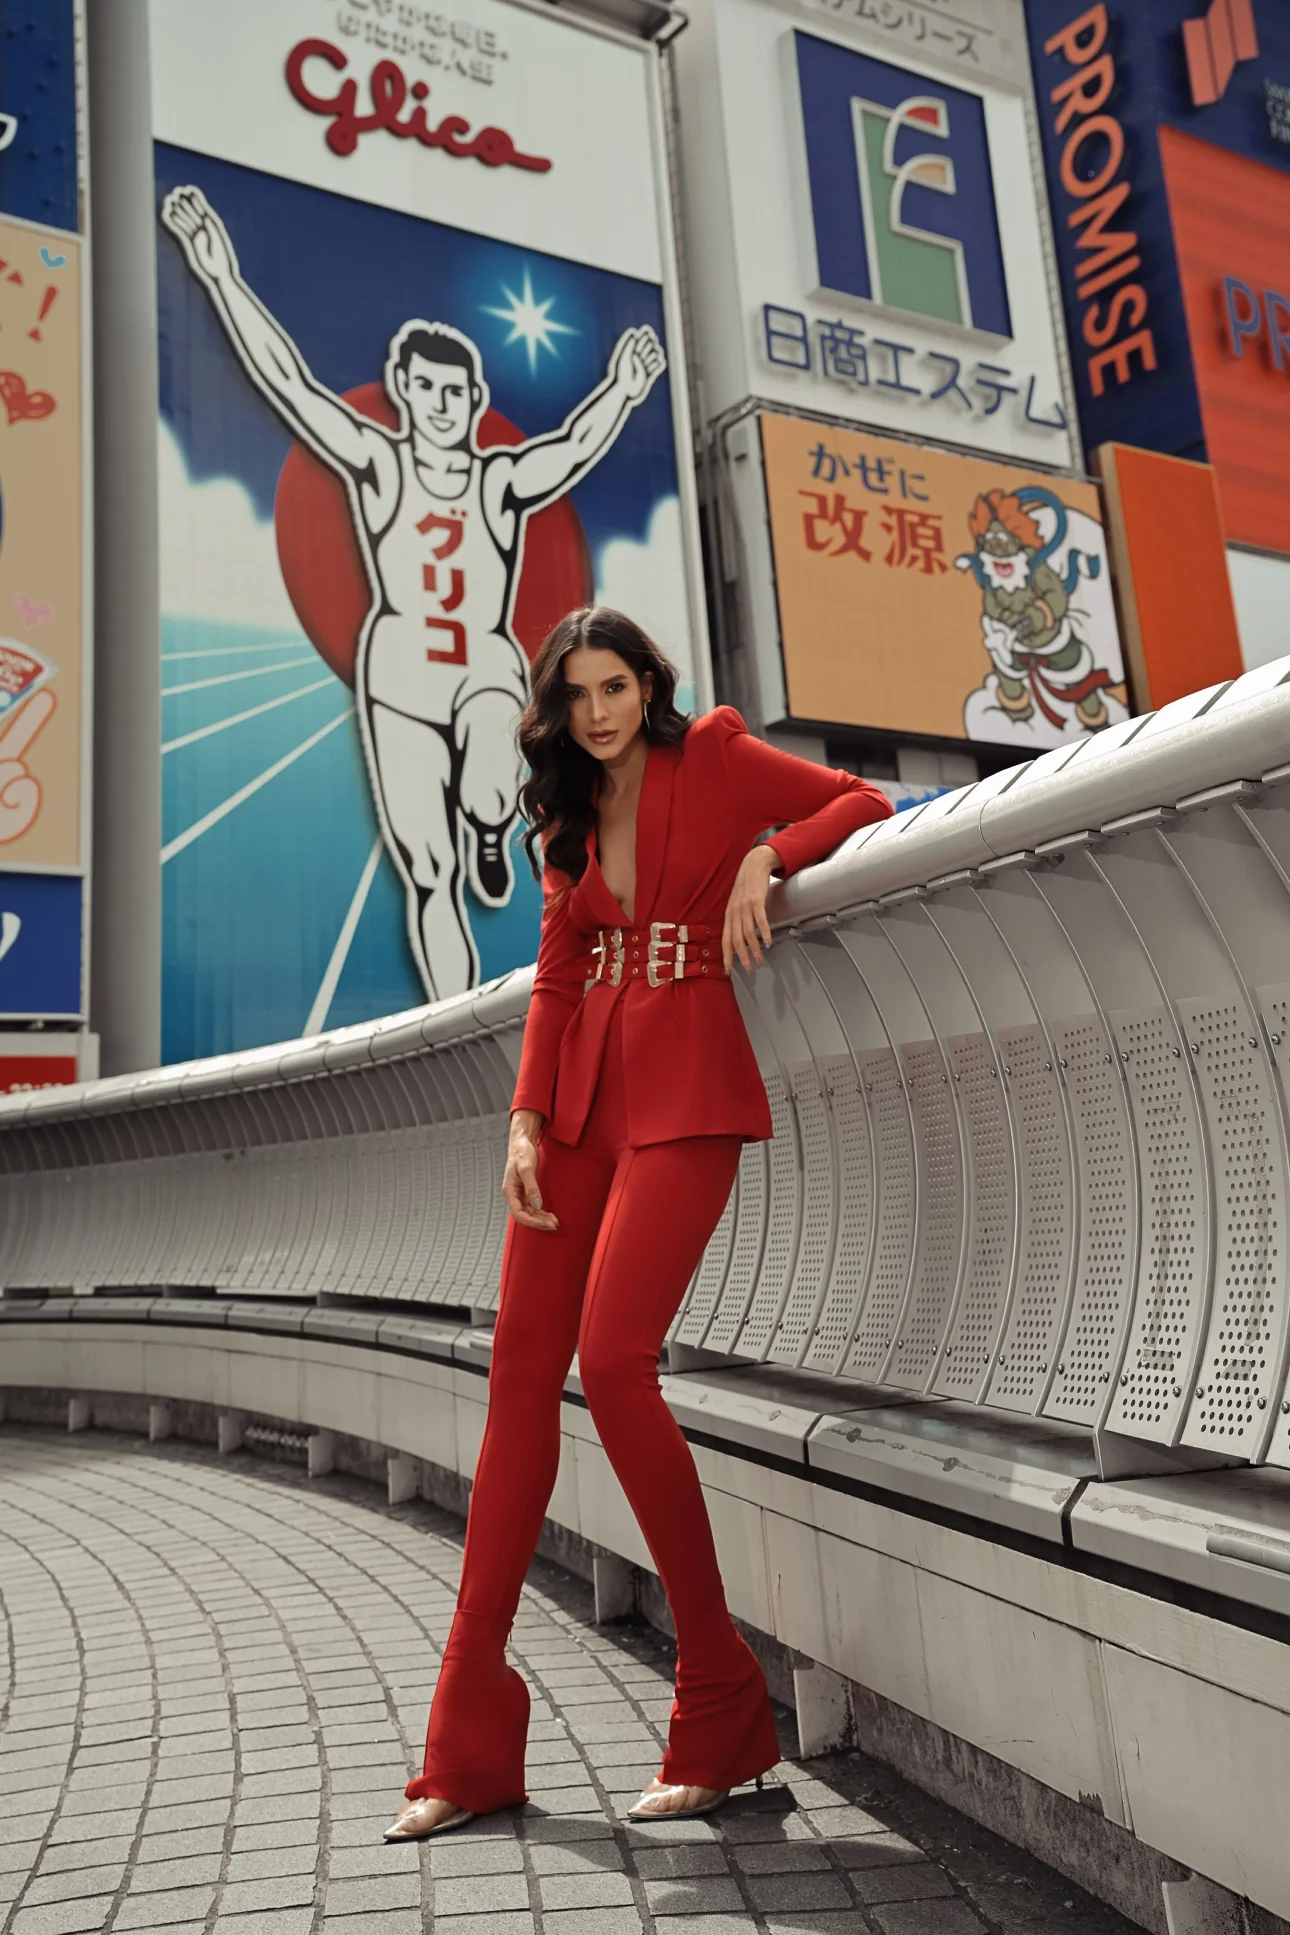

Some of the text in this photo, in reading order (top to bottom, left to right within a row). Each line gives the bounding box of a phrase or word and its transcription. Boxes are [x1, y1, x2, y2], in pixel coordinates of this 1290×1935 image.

[285, 38, 552, 173] Glico
[1044, 2, 1157, 397] PROMISE
[764, 303, 1067, 430] 日商エステム
[798, 490, 948, 575] 改源
[808, 442, 929, 502] かぜに
[416, 508, 468, 667] グリコ
